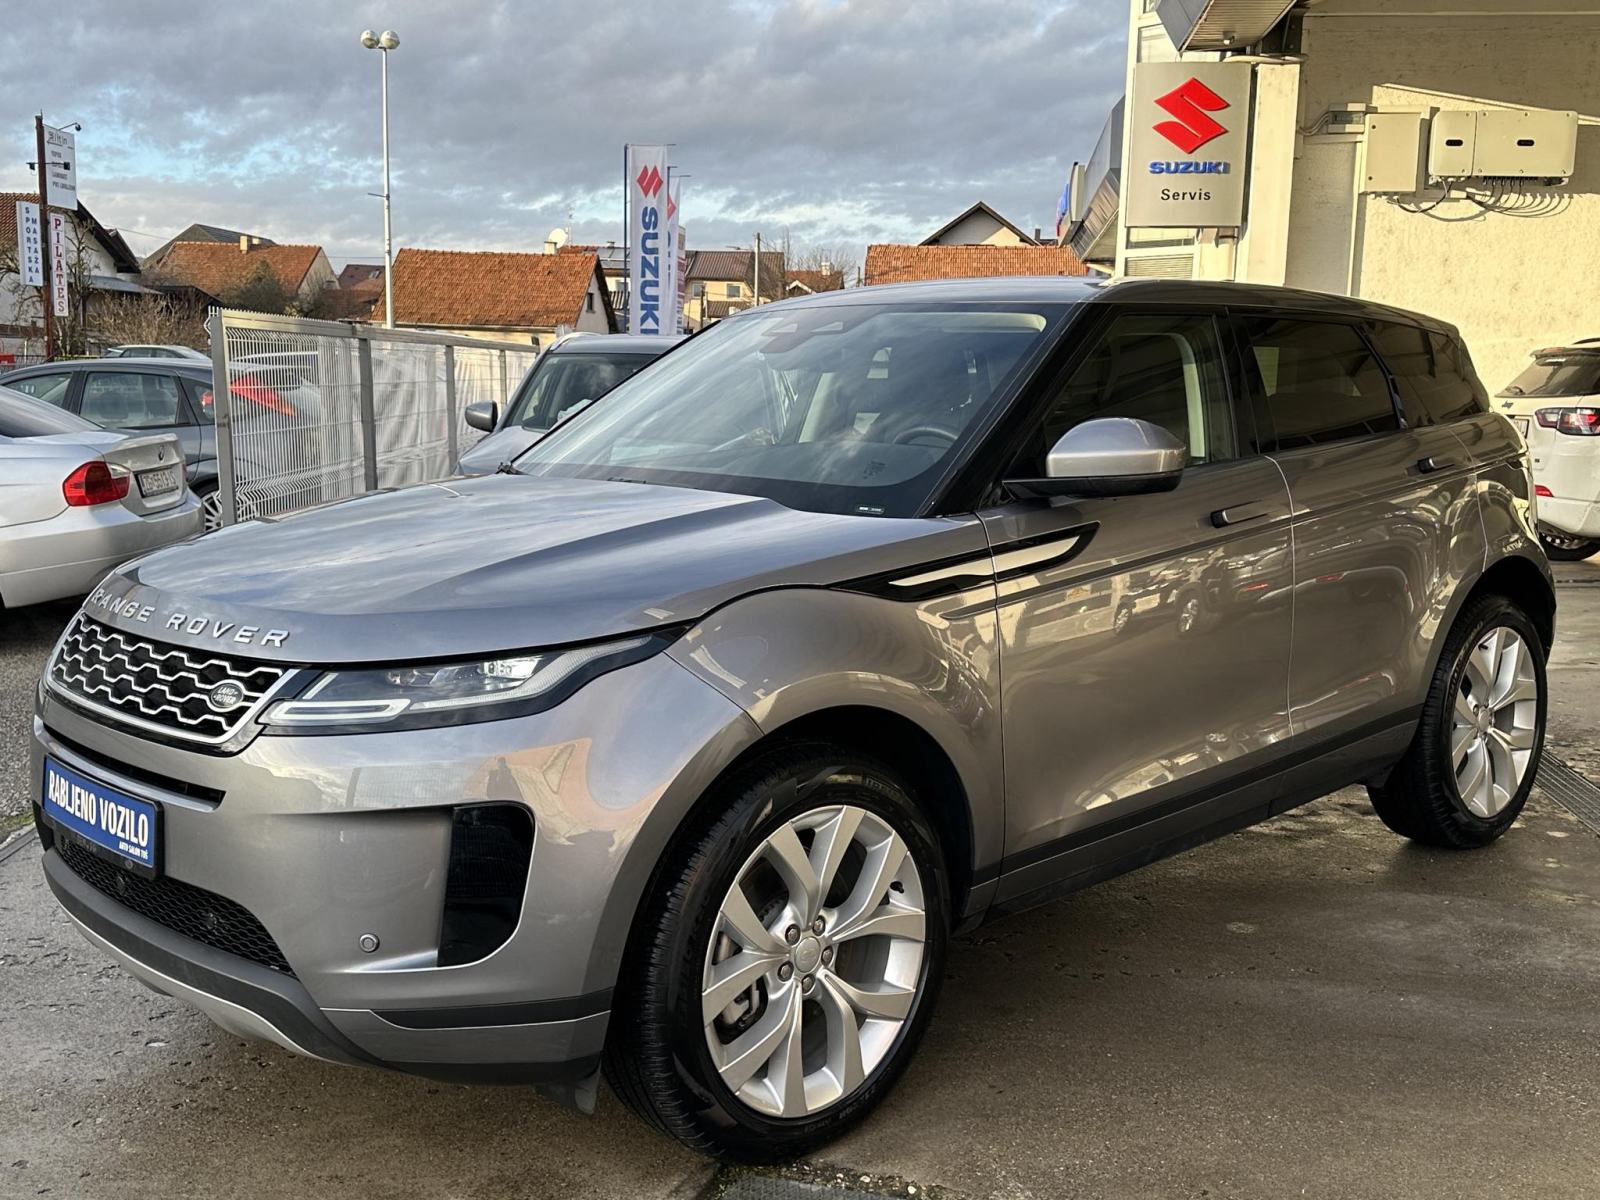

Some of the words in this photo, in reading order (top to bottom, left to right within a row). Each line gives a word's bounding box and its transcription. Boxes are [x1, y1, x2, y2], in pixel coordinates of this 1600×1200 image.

[1149, 161, 1230, 174] SUZUKI
[1160, 188, 1212, 201] Servis
[25, 206, 35, 283] SPORTSKA
[31, 217, 40, 274] MASAŽA
[53, 218, 65, 312] PILATES
[640, 206, 660, 335] SUZUKI
[91, 588, 156, 623] RANGE
[165, 613, 290, 648] ROVER
[48, 769, 97, 825] RABLJENO
[99, 797, 149, 847] VOZILO
